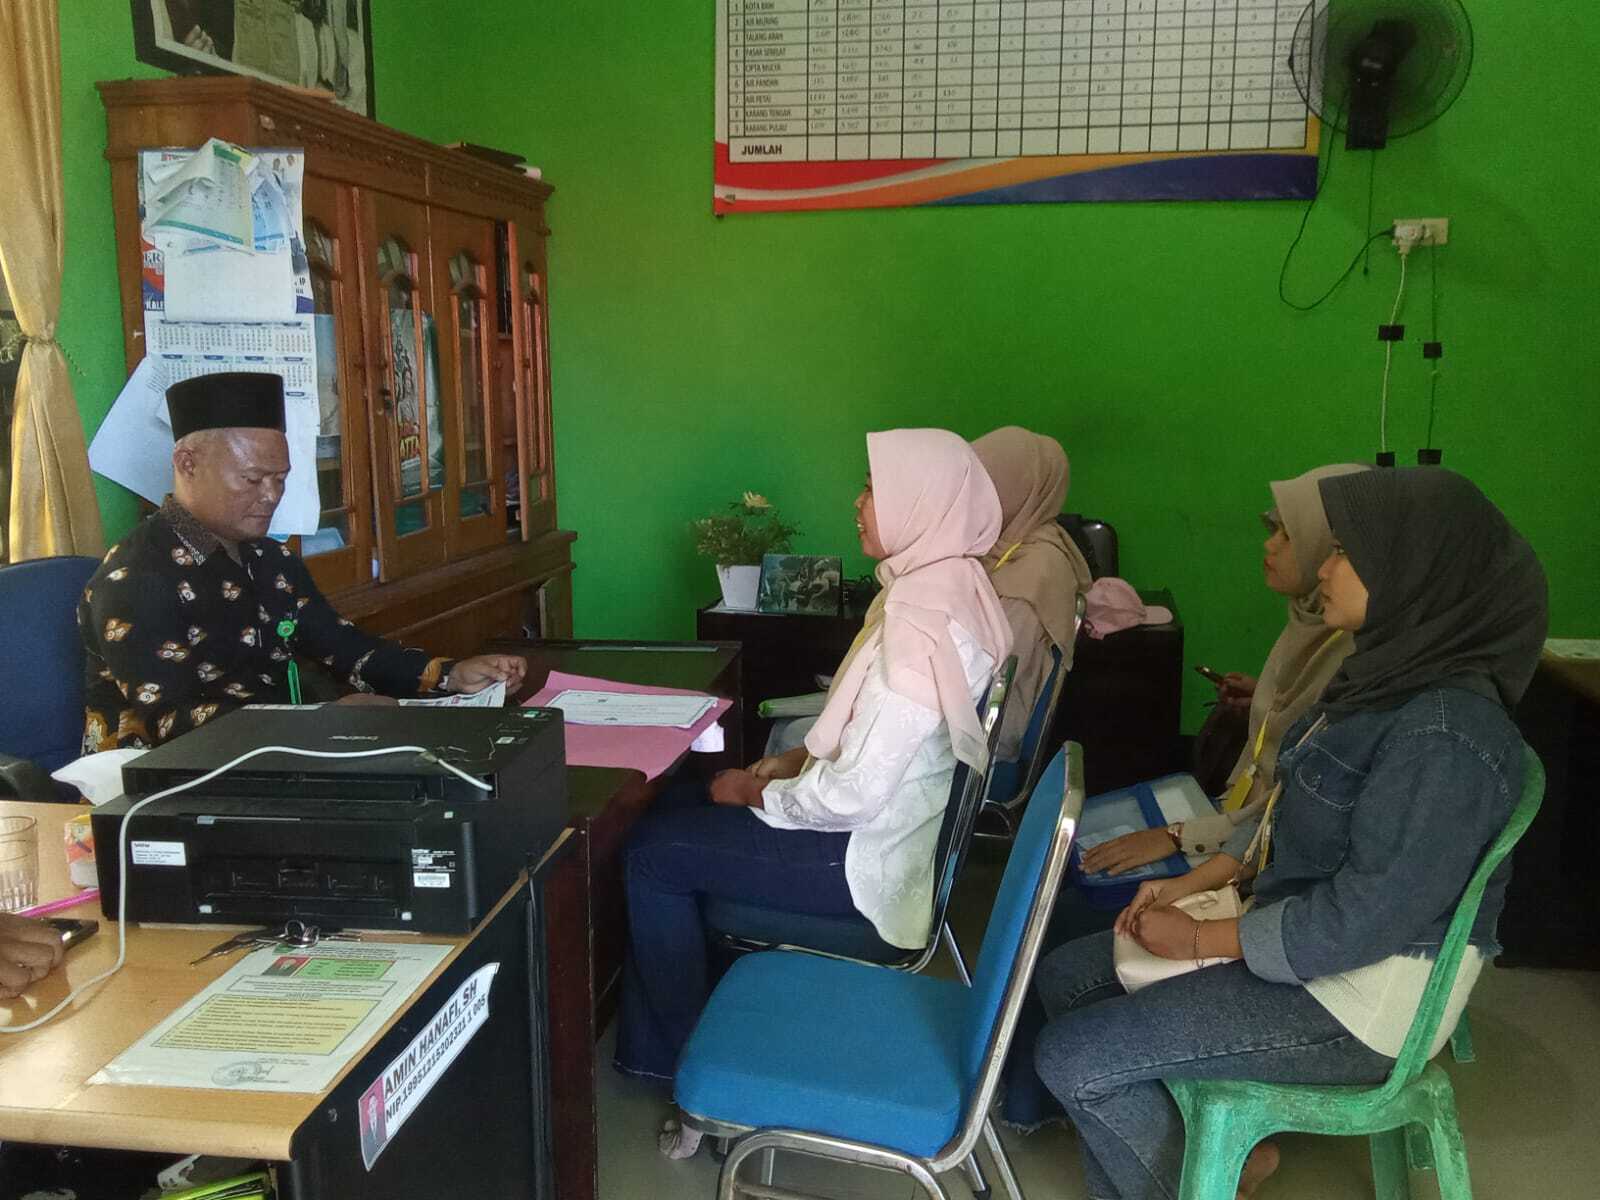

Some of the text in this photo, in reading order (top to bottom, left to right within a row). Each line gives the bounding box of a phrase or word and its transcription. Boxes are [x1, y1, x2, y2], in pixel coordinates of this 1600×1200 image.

[741, 144, 783, 156] JUMLAH
[384, 1047, 417, 1099] AMIN
[462, 978, 478, 1005] SH
